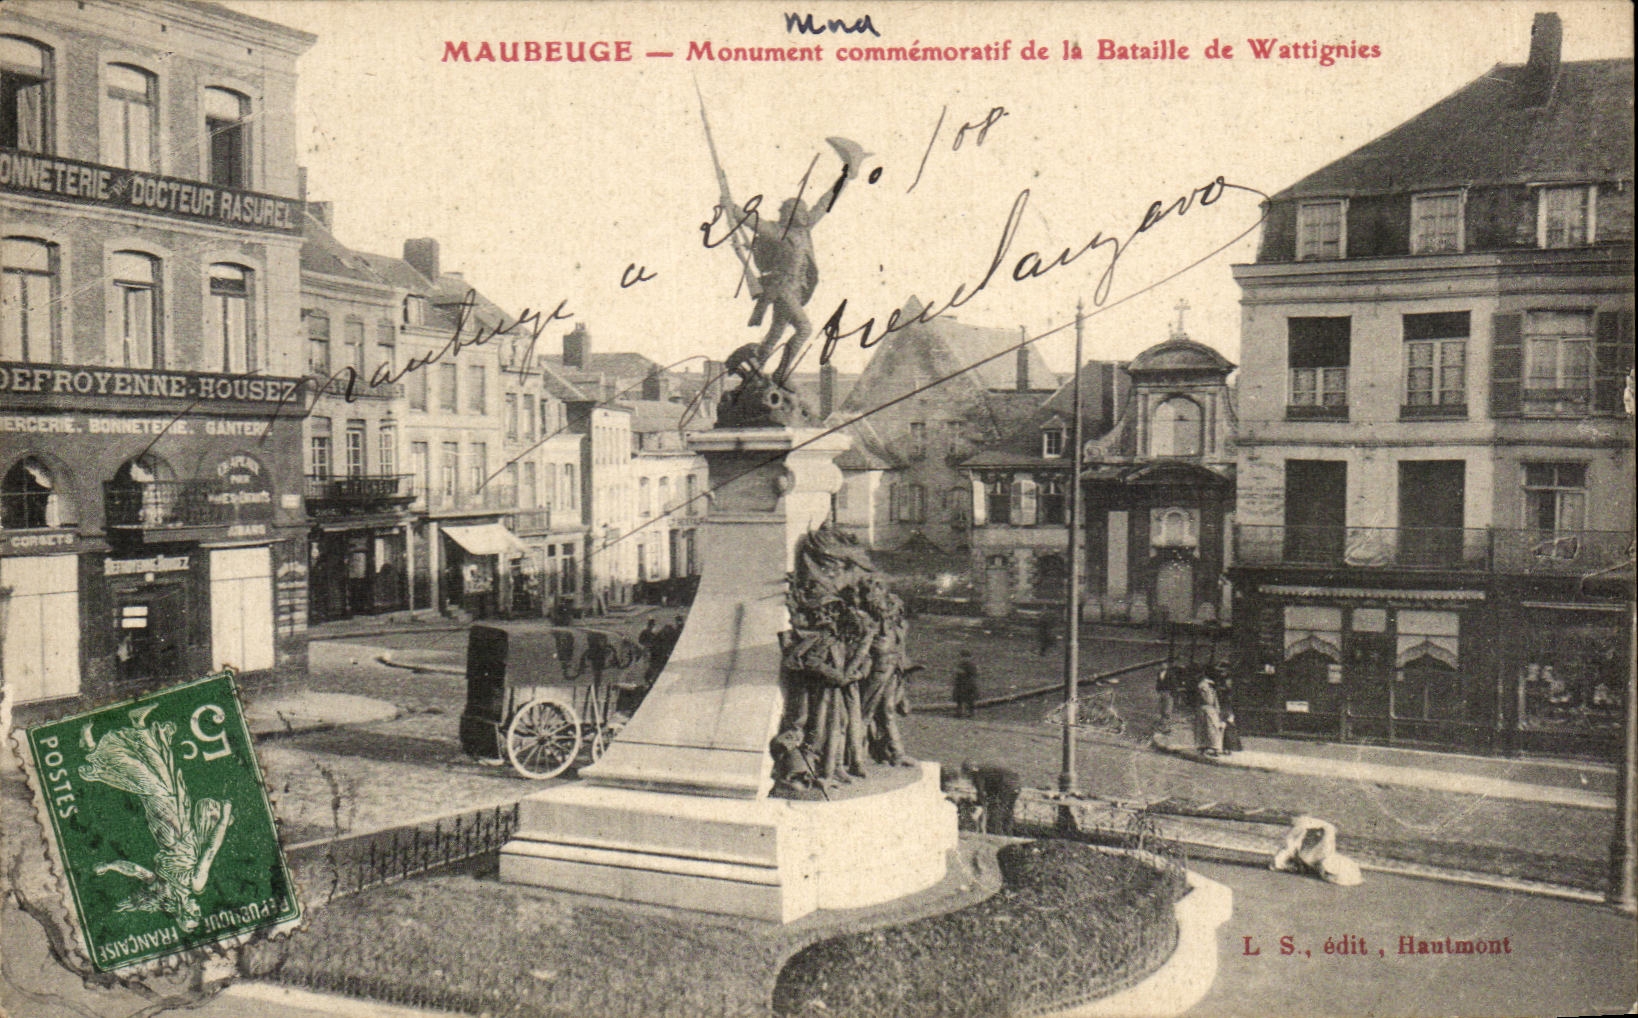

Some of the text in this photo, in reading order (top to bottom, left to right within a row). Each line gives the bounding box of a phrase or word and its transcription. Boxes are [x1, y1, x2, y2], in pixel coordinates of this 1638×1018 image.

[131, 174, 214, 217] DOCTEUR
[219, 191, 294, 230] RASUREL
[39, 735, 79, 820] POSTES
